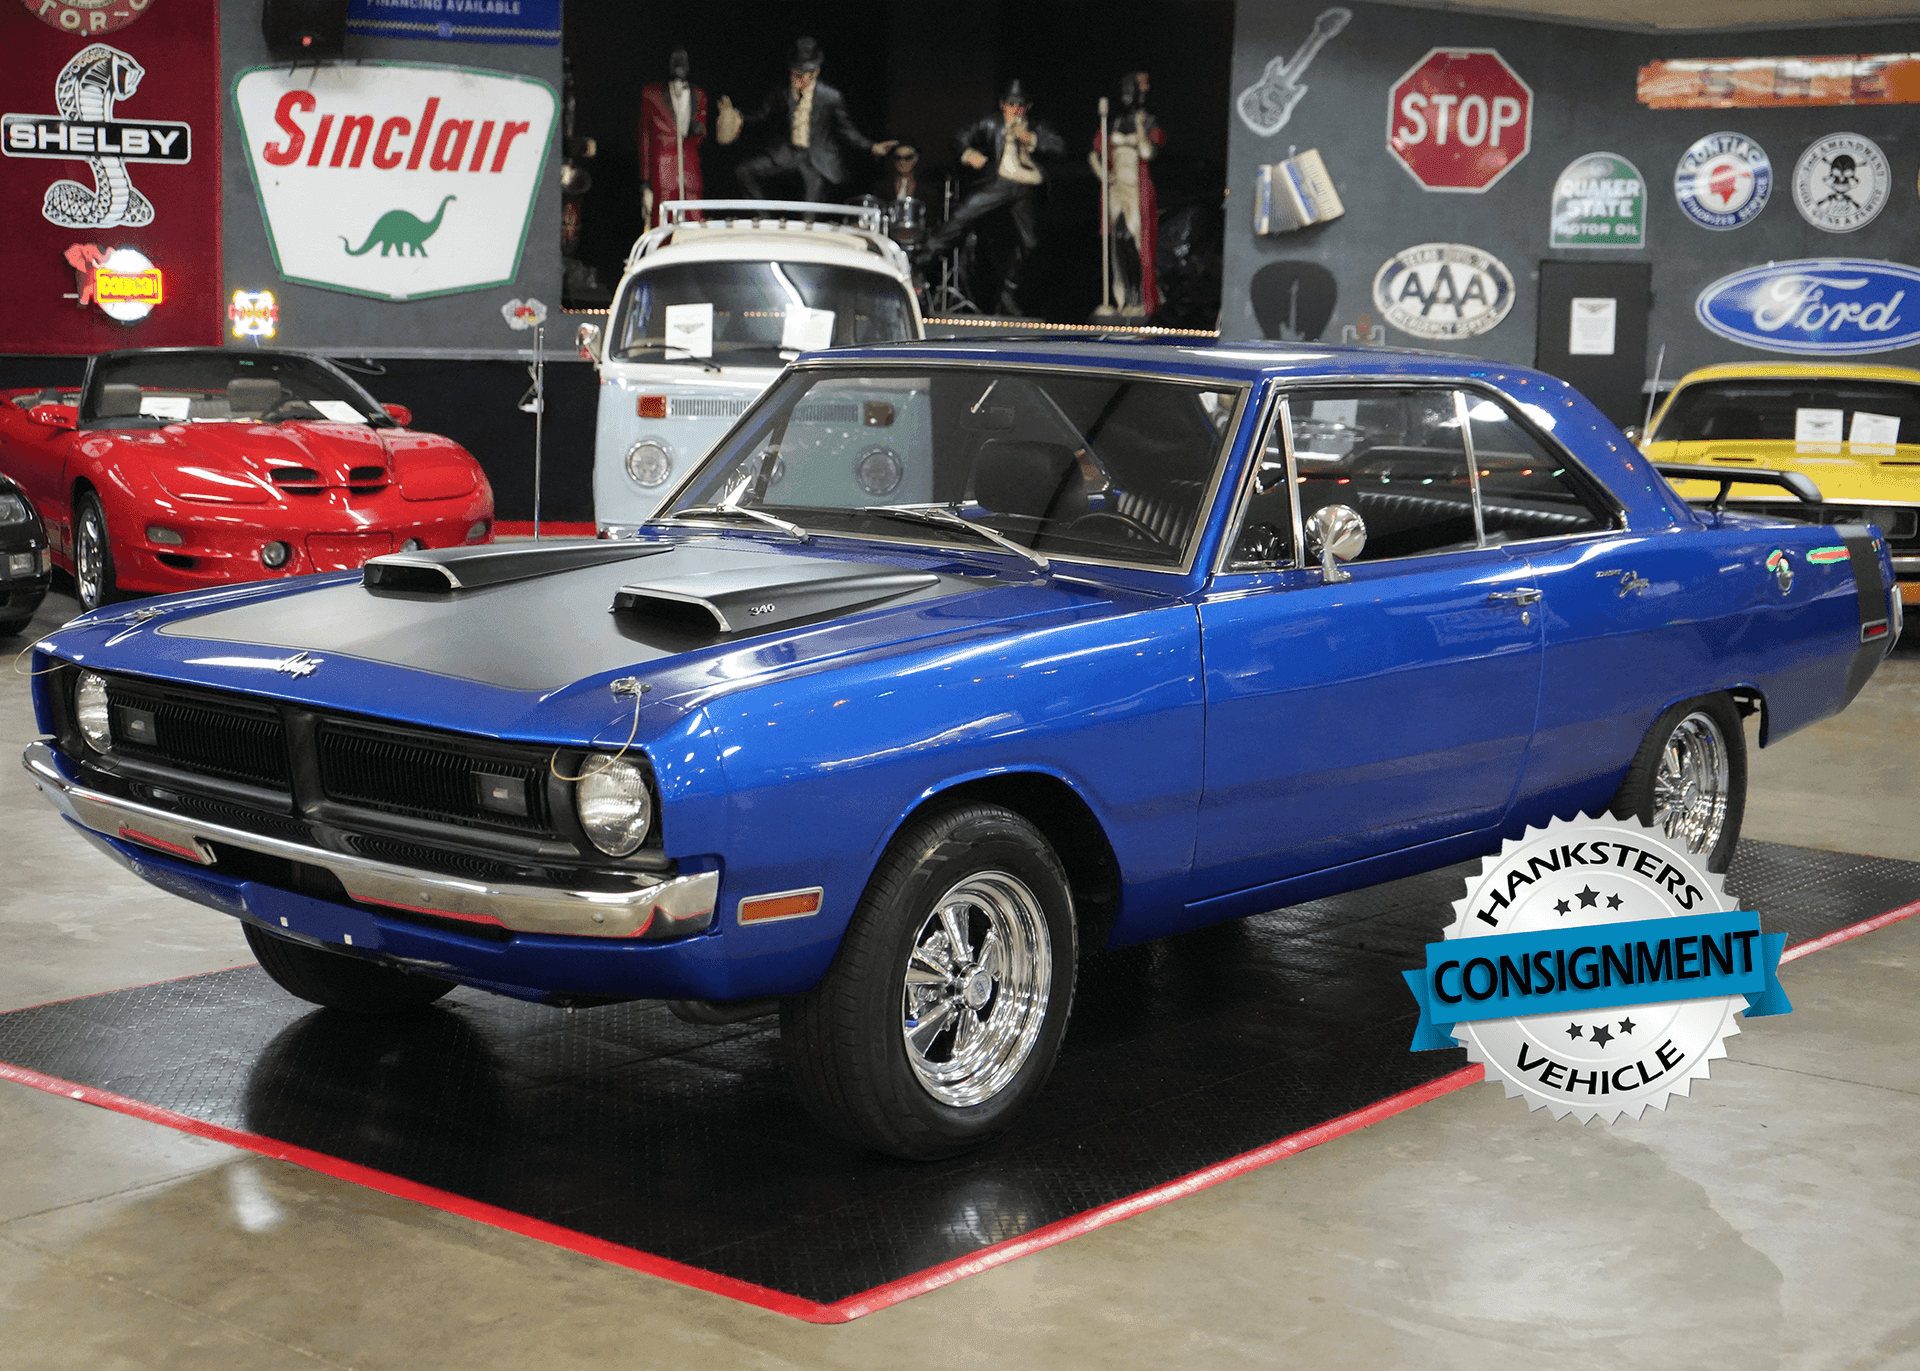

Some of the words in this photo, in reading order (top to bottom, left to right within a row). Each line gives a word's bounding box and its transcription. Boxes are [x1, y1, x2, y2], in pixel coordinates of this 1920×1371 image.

[446, 0, 521, 15] AVAILABLE
[262, 90, 531, 173] Sinclair
[1398, 92, 1522, 147] STOP
[9, 124, 180, 154] SHELBY
[1682, 136, 1764, 172] PONTIAC
[1560, 178, 1640, 198] QUAKER
[1566, 199, 1634, 217] STATE
[1557, 222, 1611, 236] MOTOR
[1615, 222, 1640, 236] OIL
[1399, 264, 1488, 318] AAA
[1754, 274, 1906, 332] Ford
[750, 603, 775, 616] 340
